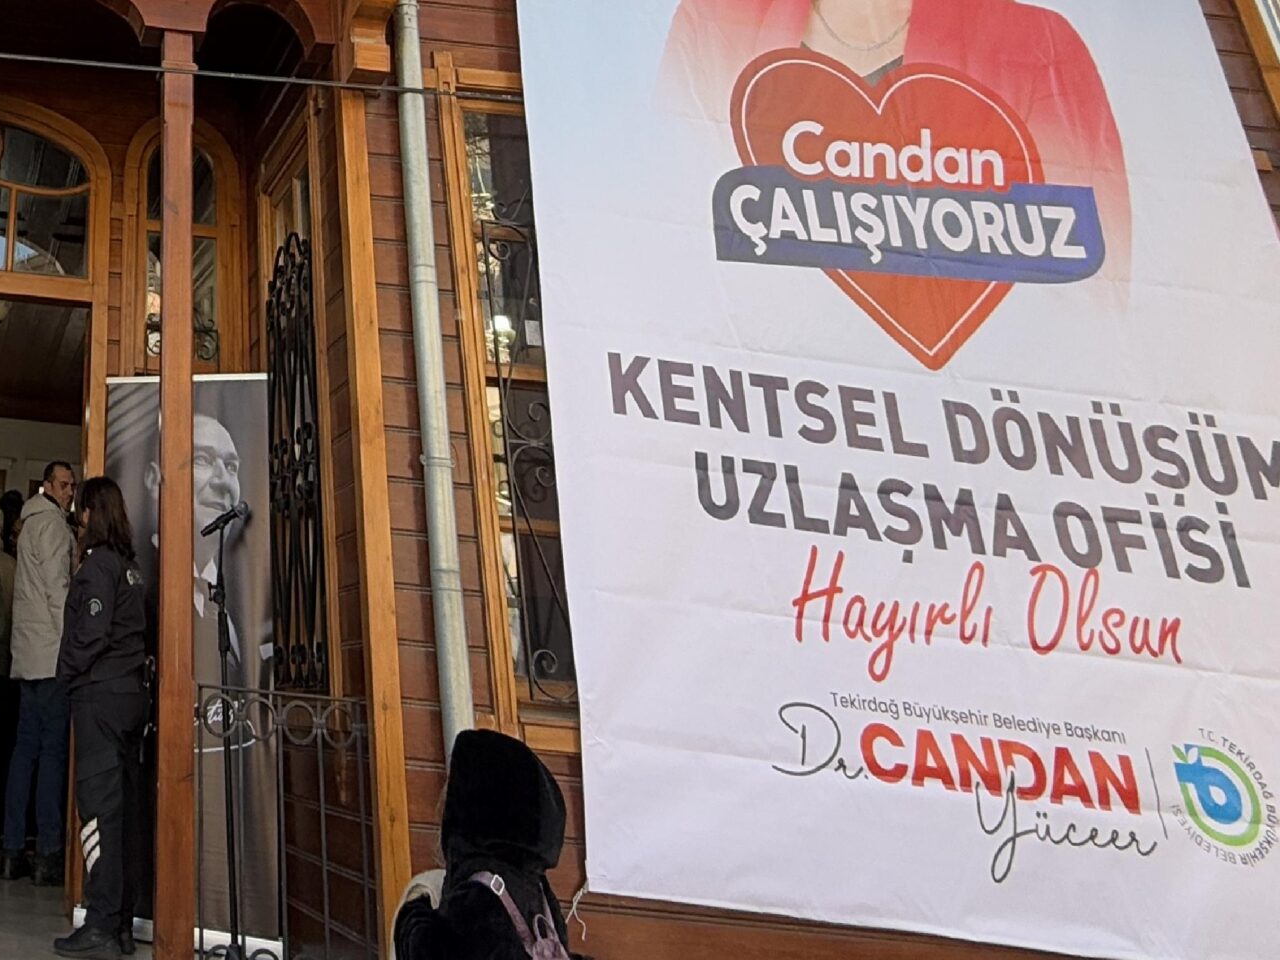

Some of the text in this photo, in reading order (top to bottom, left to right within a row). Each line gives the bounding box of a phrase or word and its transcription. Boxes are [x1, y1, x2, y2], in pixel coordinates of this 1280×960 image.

[782, 120, 1004, 186] Candan
[730, 184, 1087, 264] ÇALIŞIYORUZ
[608, 352, 1280, 507] KENTSEL DÖNÜŞÜM
[694, 451, 1251, 589] UZLAŞMA OFİSİ
[792, 545, 1183, 682] Hayırlı Olsun
[771, 701, 1142, 815] Dr. CANDAN
[830, 692, 1127, 745] Tekirdağ Büyükşehir Belediye Başkanı
[1221, 736, 1275, 801] TEKİRDAĞ
[975, 770, 1158, 883] Yüceer
[1170, 804, 1238, 866] BELEDİYESİ
